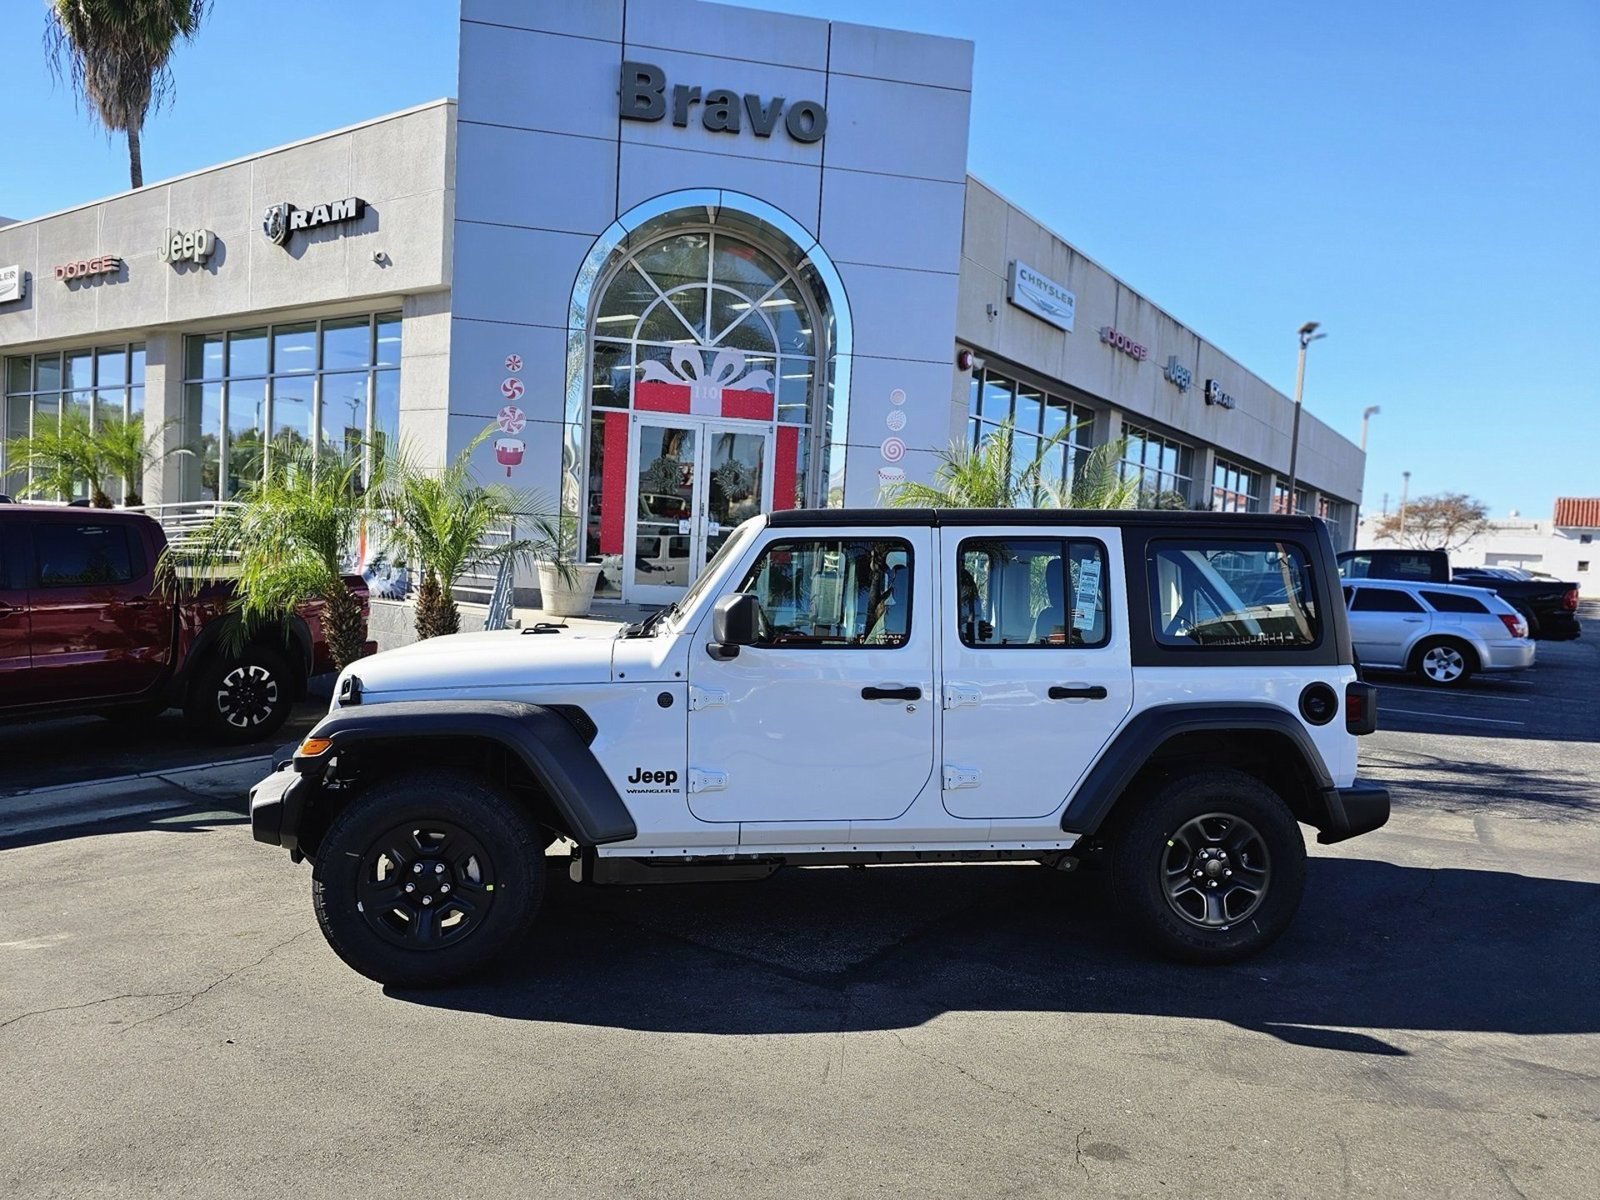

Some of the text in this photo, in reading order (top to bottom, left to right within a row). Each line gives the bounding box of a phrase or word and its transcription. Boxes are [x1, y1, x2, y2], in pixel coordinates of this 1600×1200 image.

[619, 60, 828, 144] Bravo
[289, 197, 361, 231] RAM
[157, 227, 212, 264] Jeep
[54, 255, 117, 281] DODGE
[1020, 269, 1074, 307] CHRYSLER
[1105, 326, 1148, 361] DODGE
[1165, 355, 1192, 391] Jeep
[628, 767, 678, 786] Jeep
